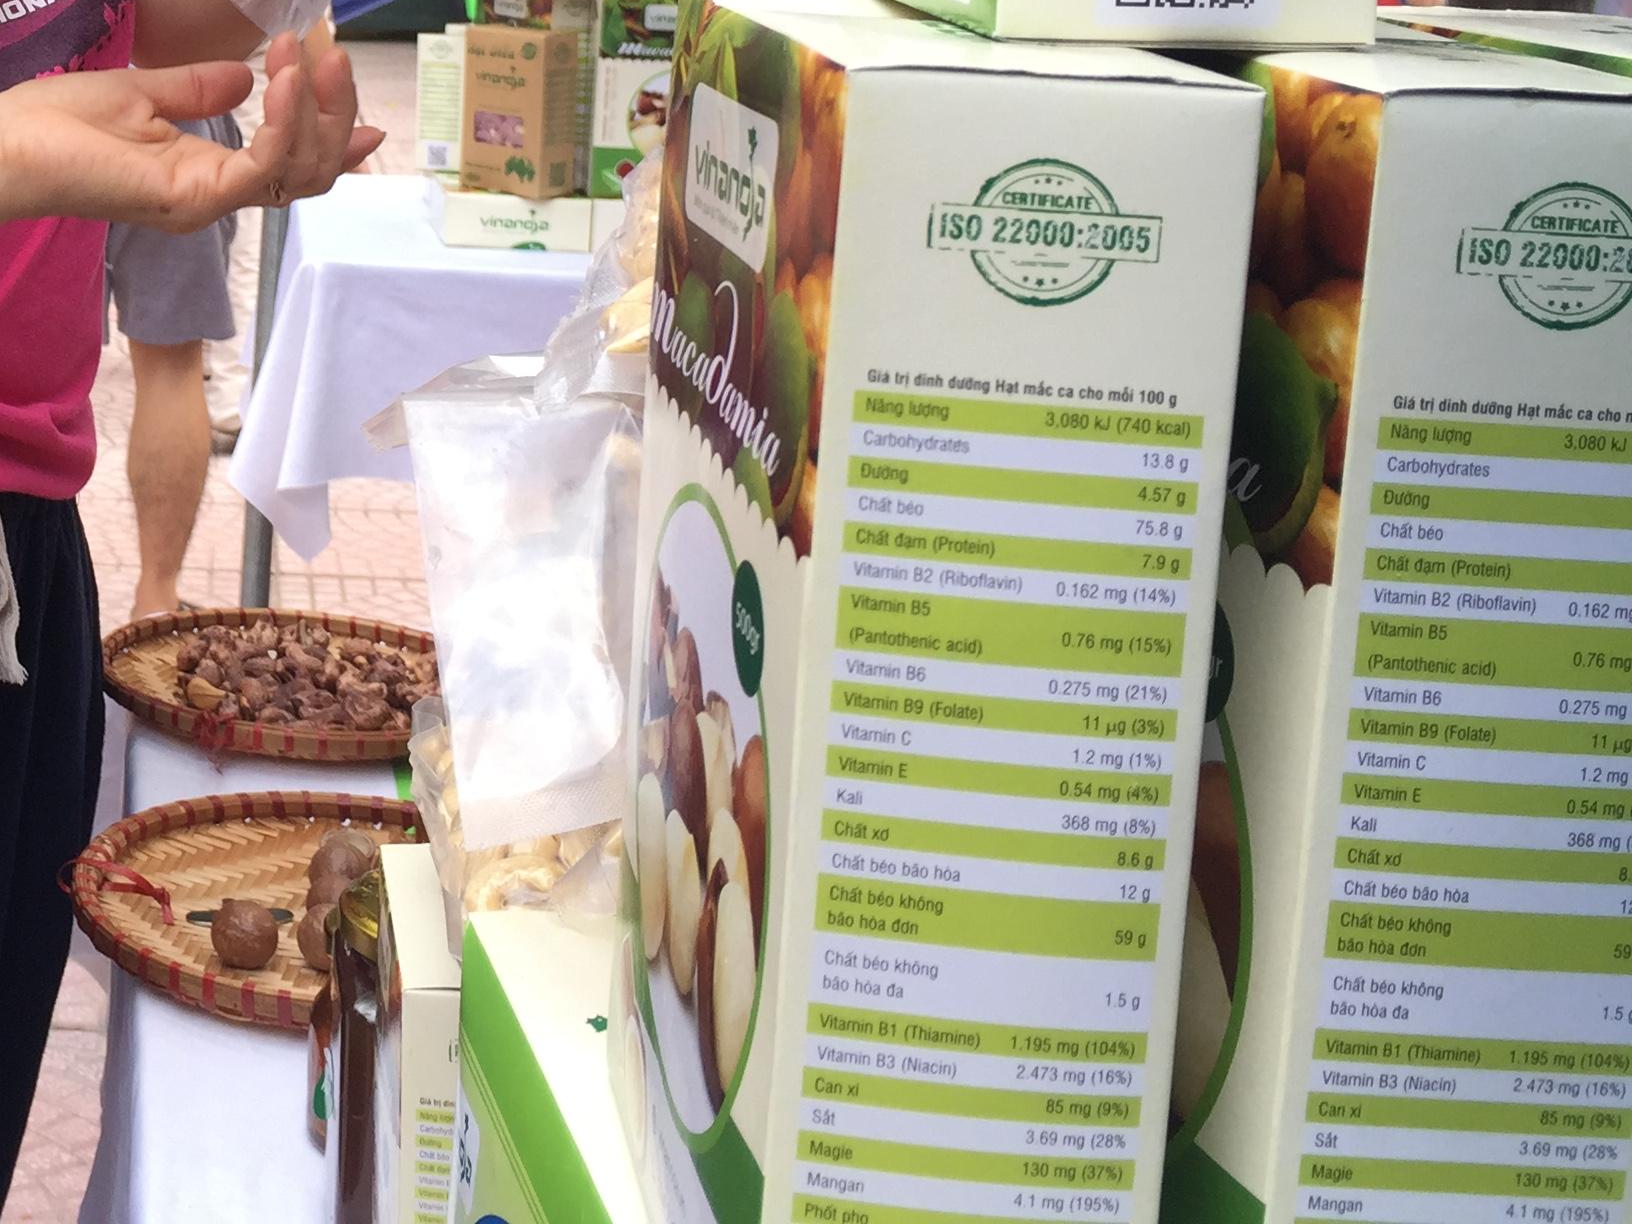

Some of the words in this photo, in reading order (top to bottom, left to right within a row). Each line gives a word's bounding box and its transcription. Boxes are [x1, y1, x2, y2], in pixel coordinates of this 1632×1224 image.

[1002, 191, 1093, 210] CERTIFICATE
[940, 213, 982, 240] ISO
[992, 216, 1151, 253] 22000:2005
[1531, 215, 1620, 234] CERTIFICATE
[1469, 237, 1512, 266] ISO
[1386, 455, 1490, 479] Carbohydrates
[1137, 485, 1172, 503] 4.57
[1176, 491, 1187, 508] g
[932, 535, 996, 560] (Protein)
[1142, 553, 1167, 571] 7.9
[1170, 558, 1181, 575] g
[1450, 559, 1511, 582] (Protein)
[1373, 587, 1427, 606] Vitamin
[1431, 591, 1451, 608] B2
[1456, 593, 1537, 616] (Riboflavin)
[1568, 601, 1610, 619] 0.162
[850, 593, 906, 614] Vitamin
[910, 599, 931, 617] B5
[1061, 631, 1096, 650] 0.76
[1099, 637, 1124, 655] mg
[1128, 636, 1172, 657] (15%)
[848, 626, 941, 651] (Pantothenic
[946, 638, 983, 658] acid)
[1364, 685, 1418, 704] Vitamin
[1422, 689, 1442, 707] B6
[1558, 698, 1601, 716] 0.275
[1604, 704, 1628, 721] mg
[838, 755, 894, 777] Vitamin
[897, 762, 908, 779] E
[1059, 780, 1092, 798] 0.54
[1097, 786, 1121, 804] mg
[1126, 785, 1159, 805] (4%)
[819, 1013, 874, 1035] Vitamin
[877, 1020, 897, 1037] B1
[903, 1024, 981, 1051] (Thiamine)
[1011, 1035, 1052, 1053] 1.195
[1056, 1041, 1080, 1058] mg
[1084, 1040, 1136, 1060] (104%)
[809, 1139, 853, 1162] Magie
[1023, 1161, 1050, 1178] 130
[1053, 1166, 1077, 1183] mg
[1081, 1164, 1123, 1184] (37%)
[1519, 1140, 1551, 1158] 3.69
[1555, 1145, 1578, 1162] mg
[1582, 1143, 1618, 1162] (28%
